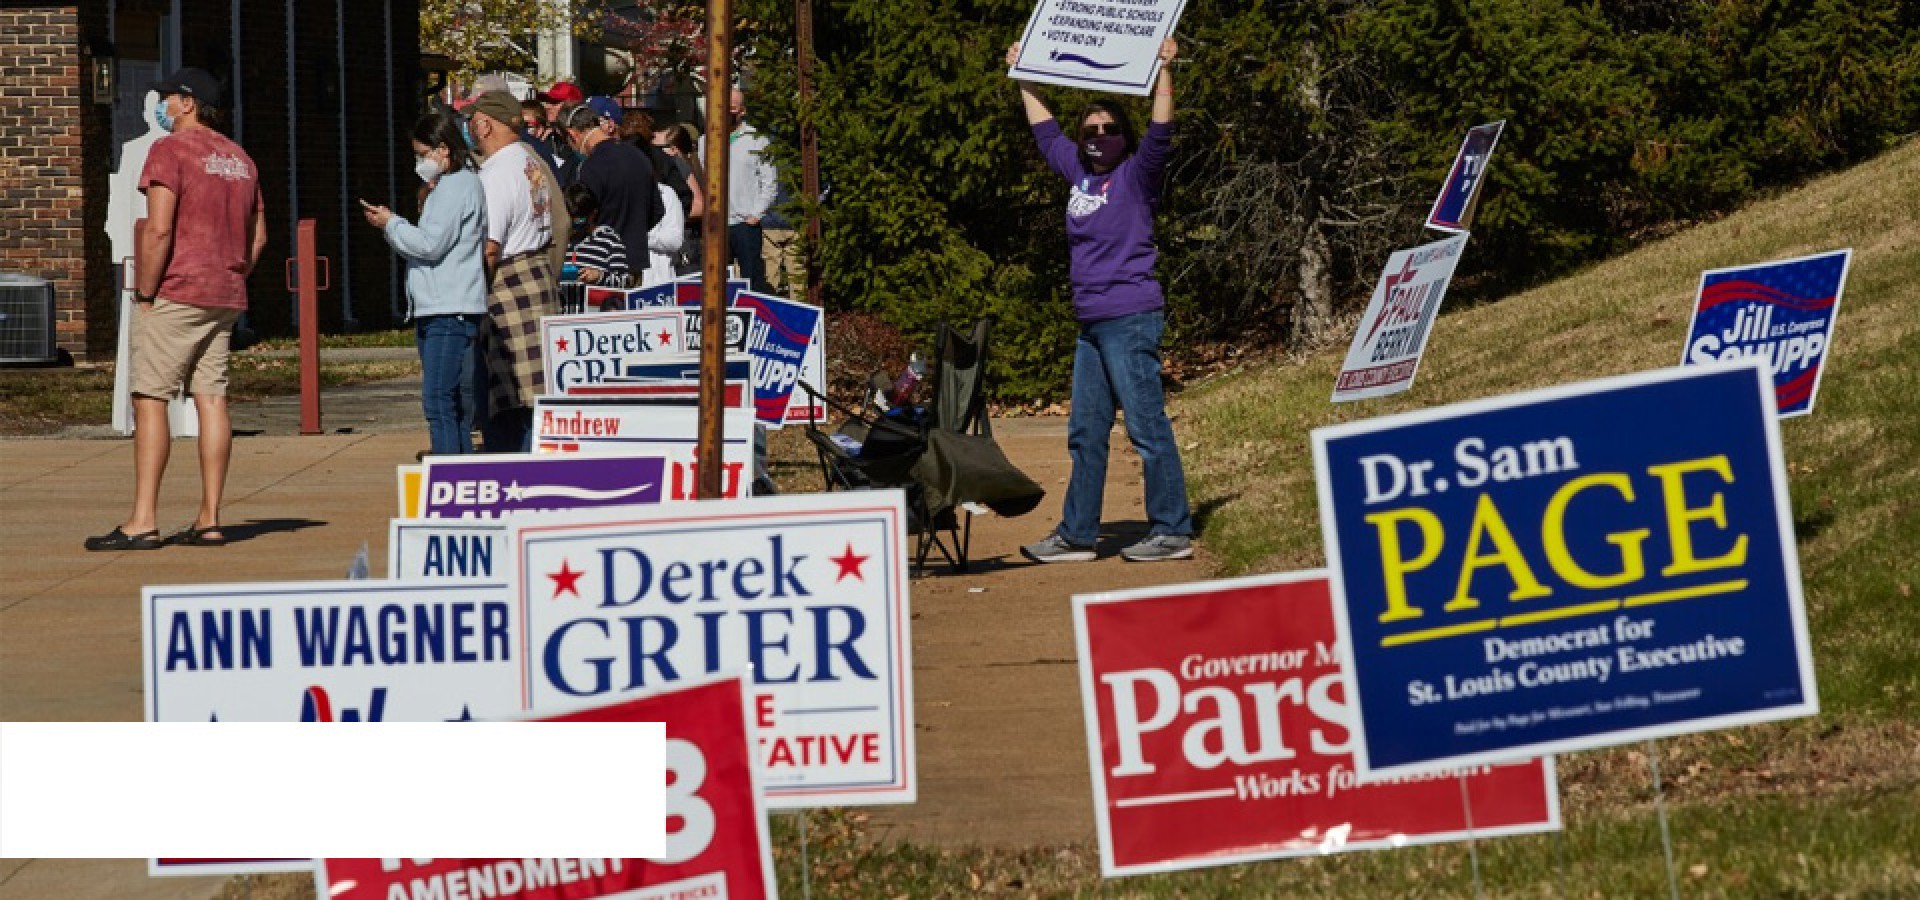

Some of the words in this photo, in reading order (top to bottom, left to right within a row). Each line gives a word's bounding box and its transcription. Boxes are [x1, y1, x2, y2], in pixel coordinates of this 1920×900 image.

[1051, 15, 1102, 30] EXPANDING
[1102, 22, 1156, 37] HEALTHCARE
[1059, 1, 1096, 14] STRONG
[1096, 6, 1127, 19] PUBLIC
[1126, 9, 1164, 22] SCHOOLS
[1047, 30, 1070, 42] VOTE
[1069, 33, 1084, 45] NO
[1084, 35, 1098, 46] ON
[1384, 283, 1430, 327] PAUL
[1722, 302, 1774, 343] Jill
[573, 323, 653, 357] Derek
[1371, 324, 1418, 363] BERRY
[540, 410, 621, 437] Andrew
[1359, 453, 1450, 505] Dr.
[1453, 435, 1579, 488] Sam
[430, 480, 500, 505] DEB
[423, 535, 492, 577] ANN
[1364, 454, 1749, 623] PAGE
[596, 533, 813, 609] Derek
[165, 608, 272, 672] ANN
[294, 601, 511, 668] WAGNER
[542, 604, 879, 697] GRIER
[1483, 622, 1611, 664] Democrat
[1615, 617, 1654, 644] for
[1180, 649, 1308, 682] Governor
[1408, 681, 1442, 705] St.
[1446, 668, 1514, 700] Louis
[1517, 655, 1613, 689] County
[1618, 635, 1746, 673] Executive
[1234, 770, 1321, 801] Works
